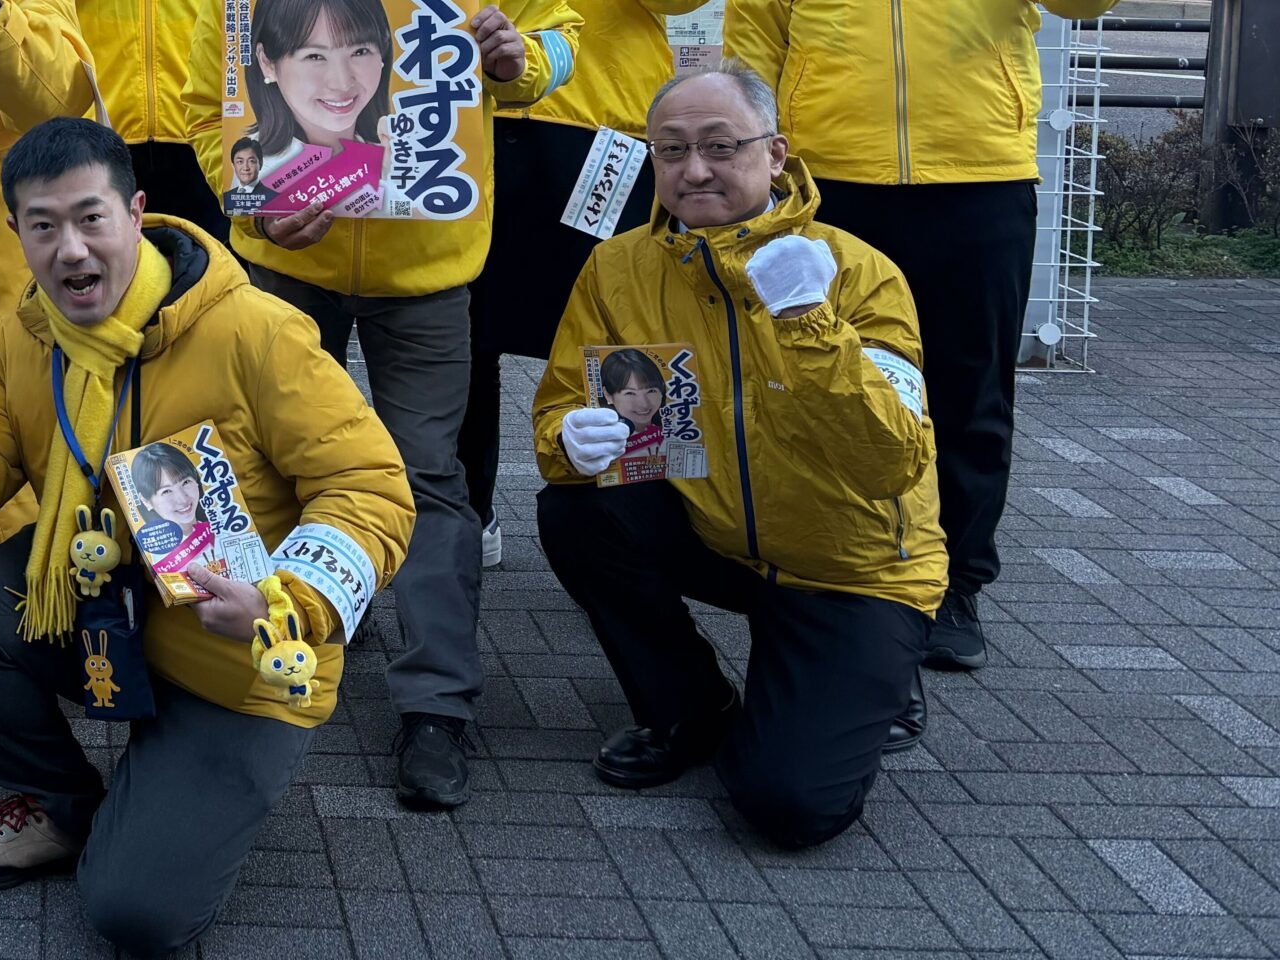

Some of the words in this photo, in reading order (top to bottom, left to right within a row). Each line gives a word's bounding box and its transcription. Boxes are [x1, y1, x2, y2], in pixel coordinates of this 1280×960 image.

[390, 112, 417, 190] ゆき子
[289, 173, 336, 204] 『もっと』
[661, 407, 675, 438] ゆき子
[669, 351, 699, 441] くわずる
[195, 427, 249, 533] くわずる
[201, 496, 224, 536] ゆき子
